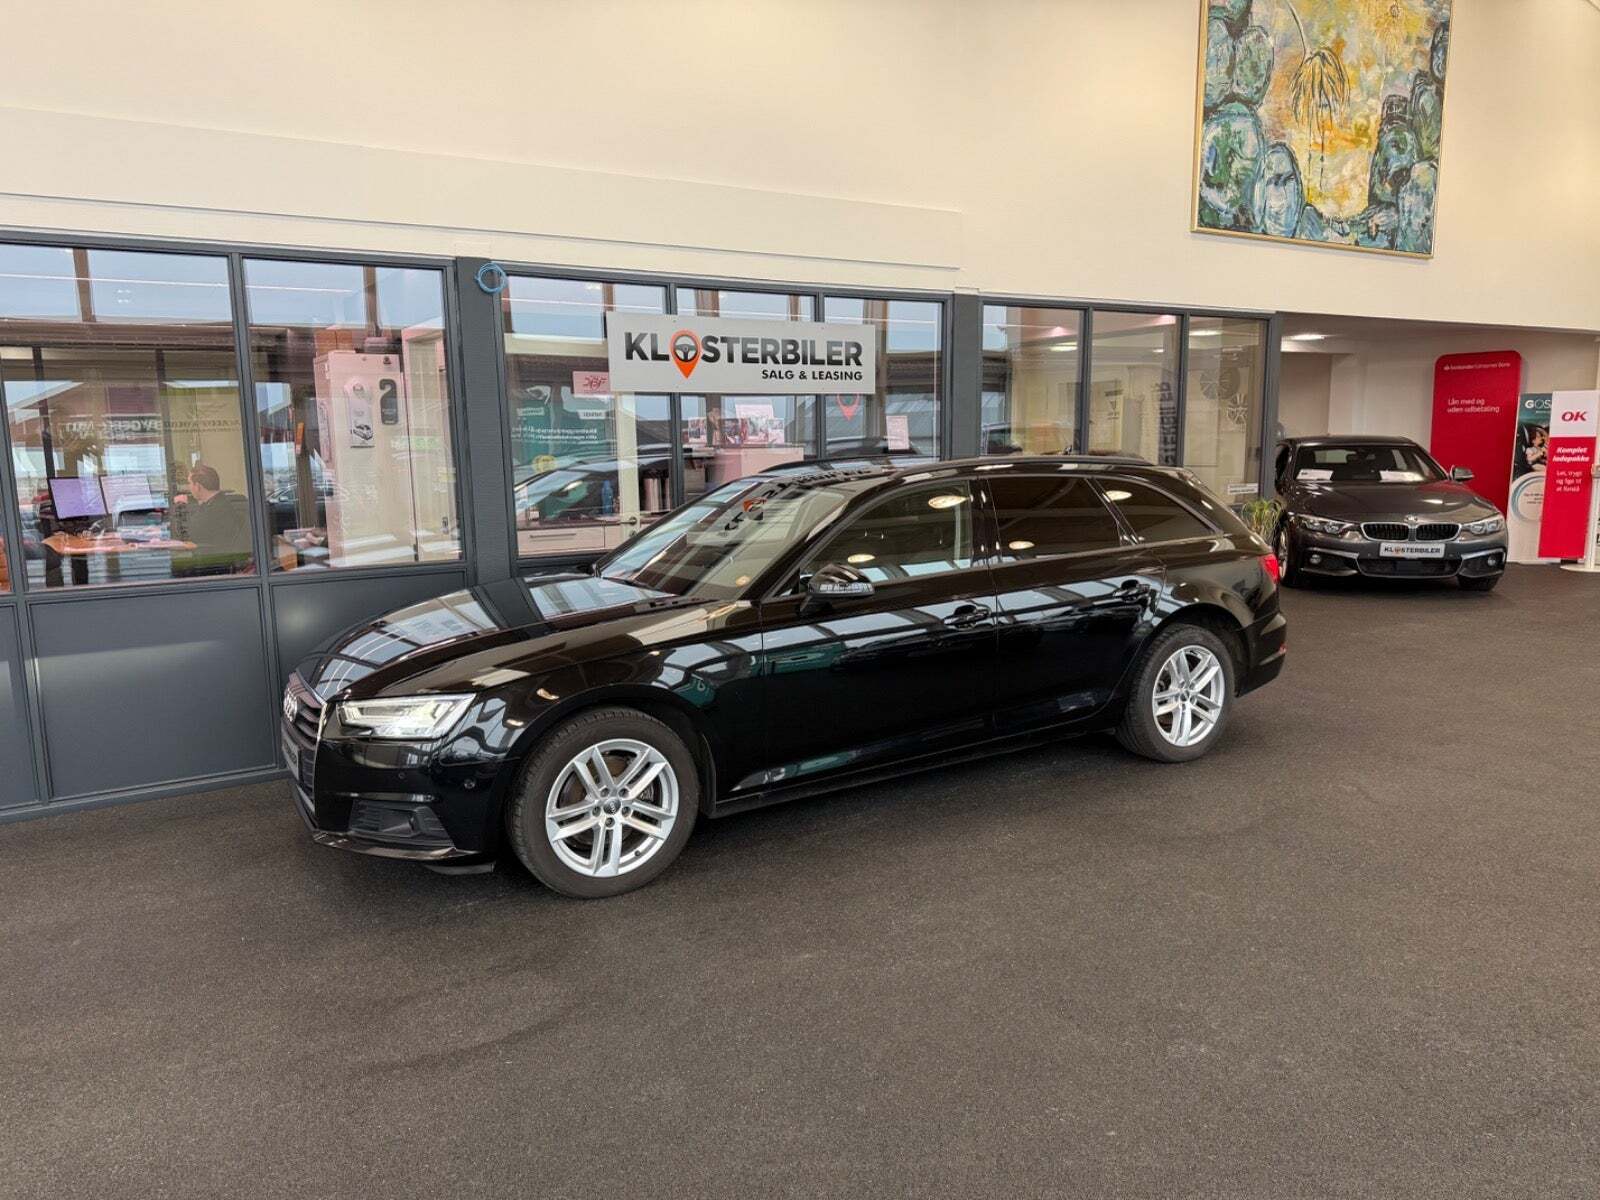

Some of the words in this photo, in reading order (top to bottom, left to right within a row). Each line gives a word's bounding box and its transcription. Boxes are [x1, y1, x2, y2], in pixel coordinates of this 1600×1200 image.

[761, 369, 794, 380] SALG
[798, 369, 808, 380] &
[811, 370, 863, 381] LEASING
[1525, 399, 1552, 409] GOS
[1561, 411, 1587, 422] OK
